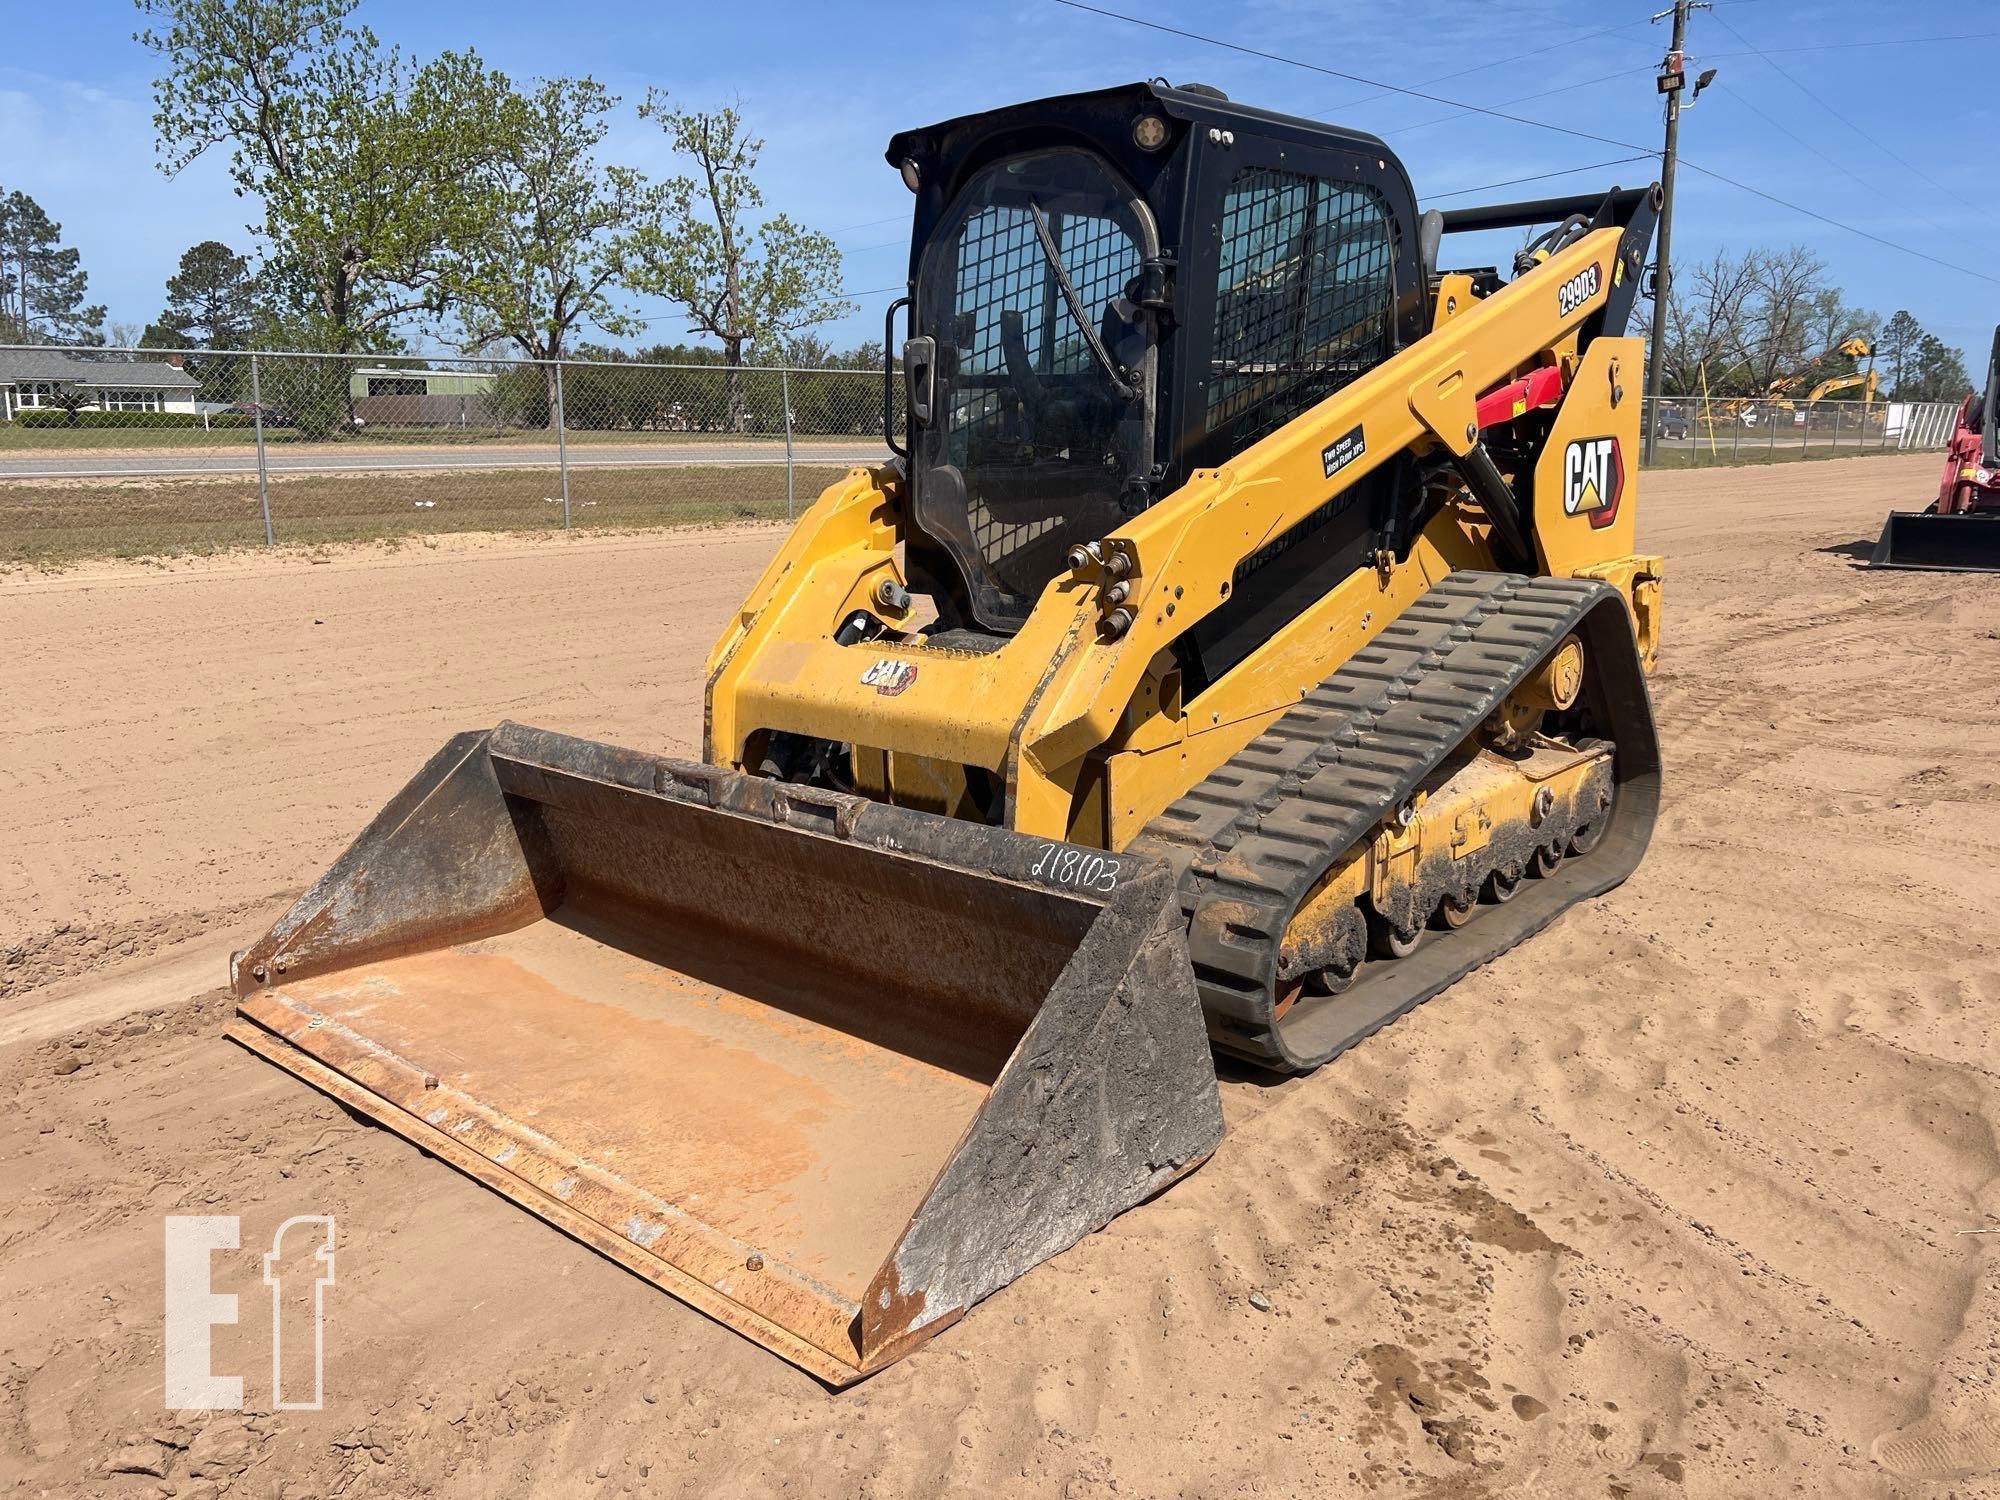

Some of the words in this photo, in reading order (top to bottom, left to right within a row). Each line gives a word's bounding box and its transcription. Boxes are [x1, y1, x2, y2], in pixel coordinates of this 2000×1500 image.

[1559, 266, 1597, 317] 299D3
[1324, 449, 1336, 462] TWO
[1336, 437, 1352, 454] SPEED
[1353, 441, 1364, 456] XPS
[1565, 439, 1612, 513] CAT
[1031, 843, 1120, 891] 218103
